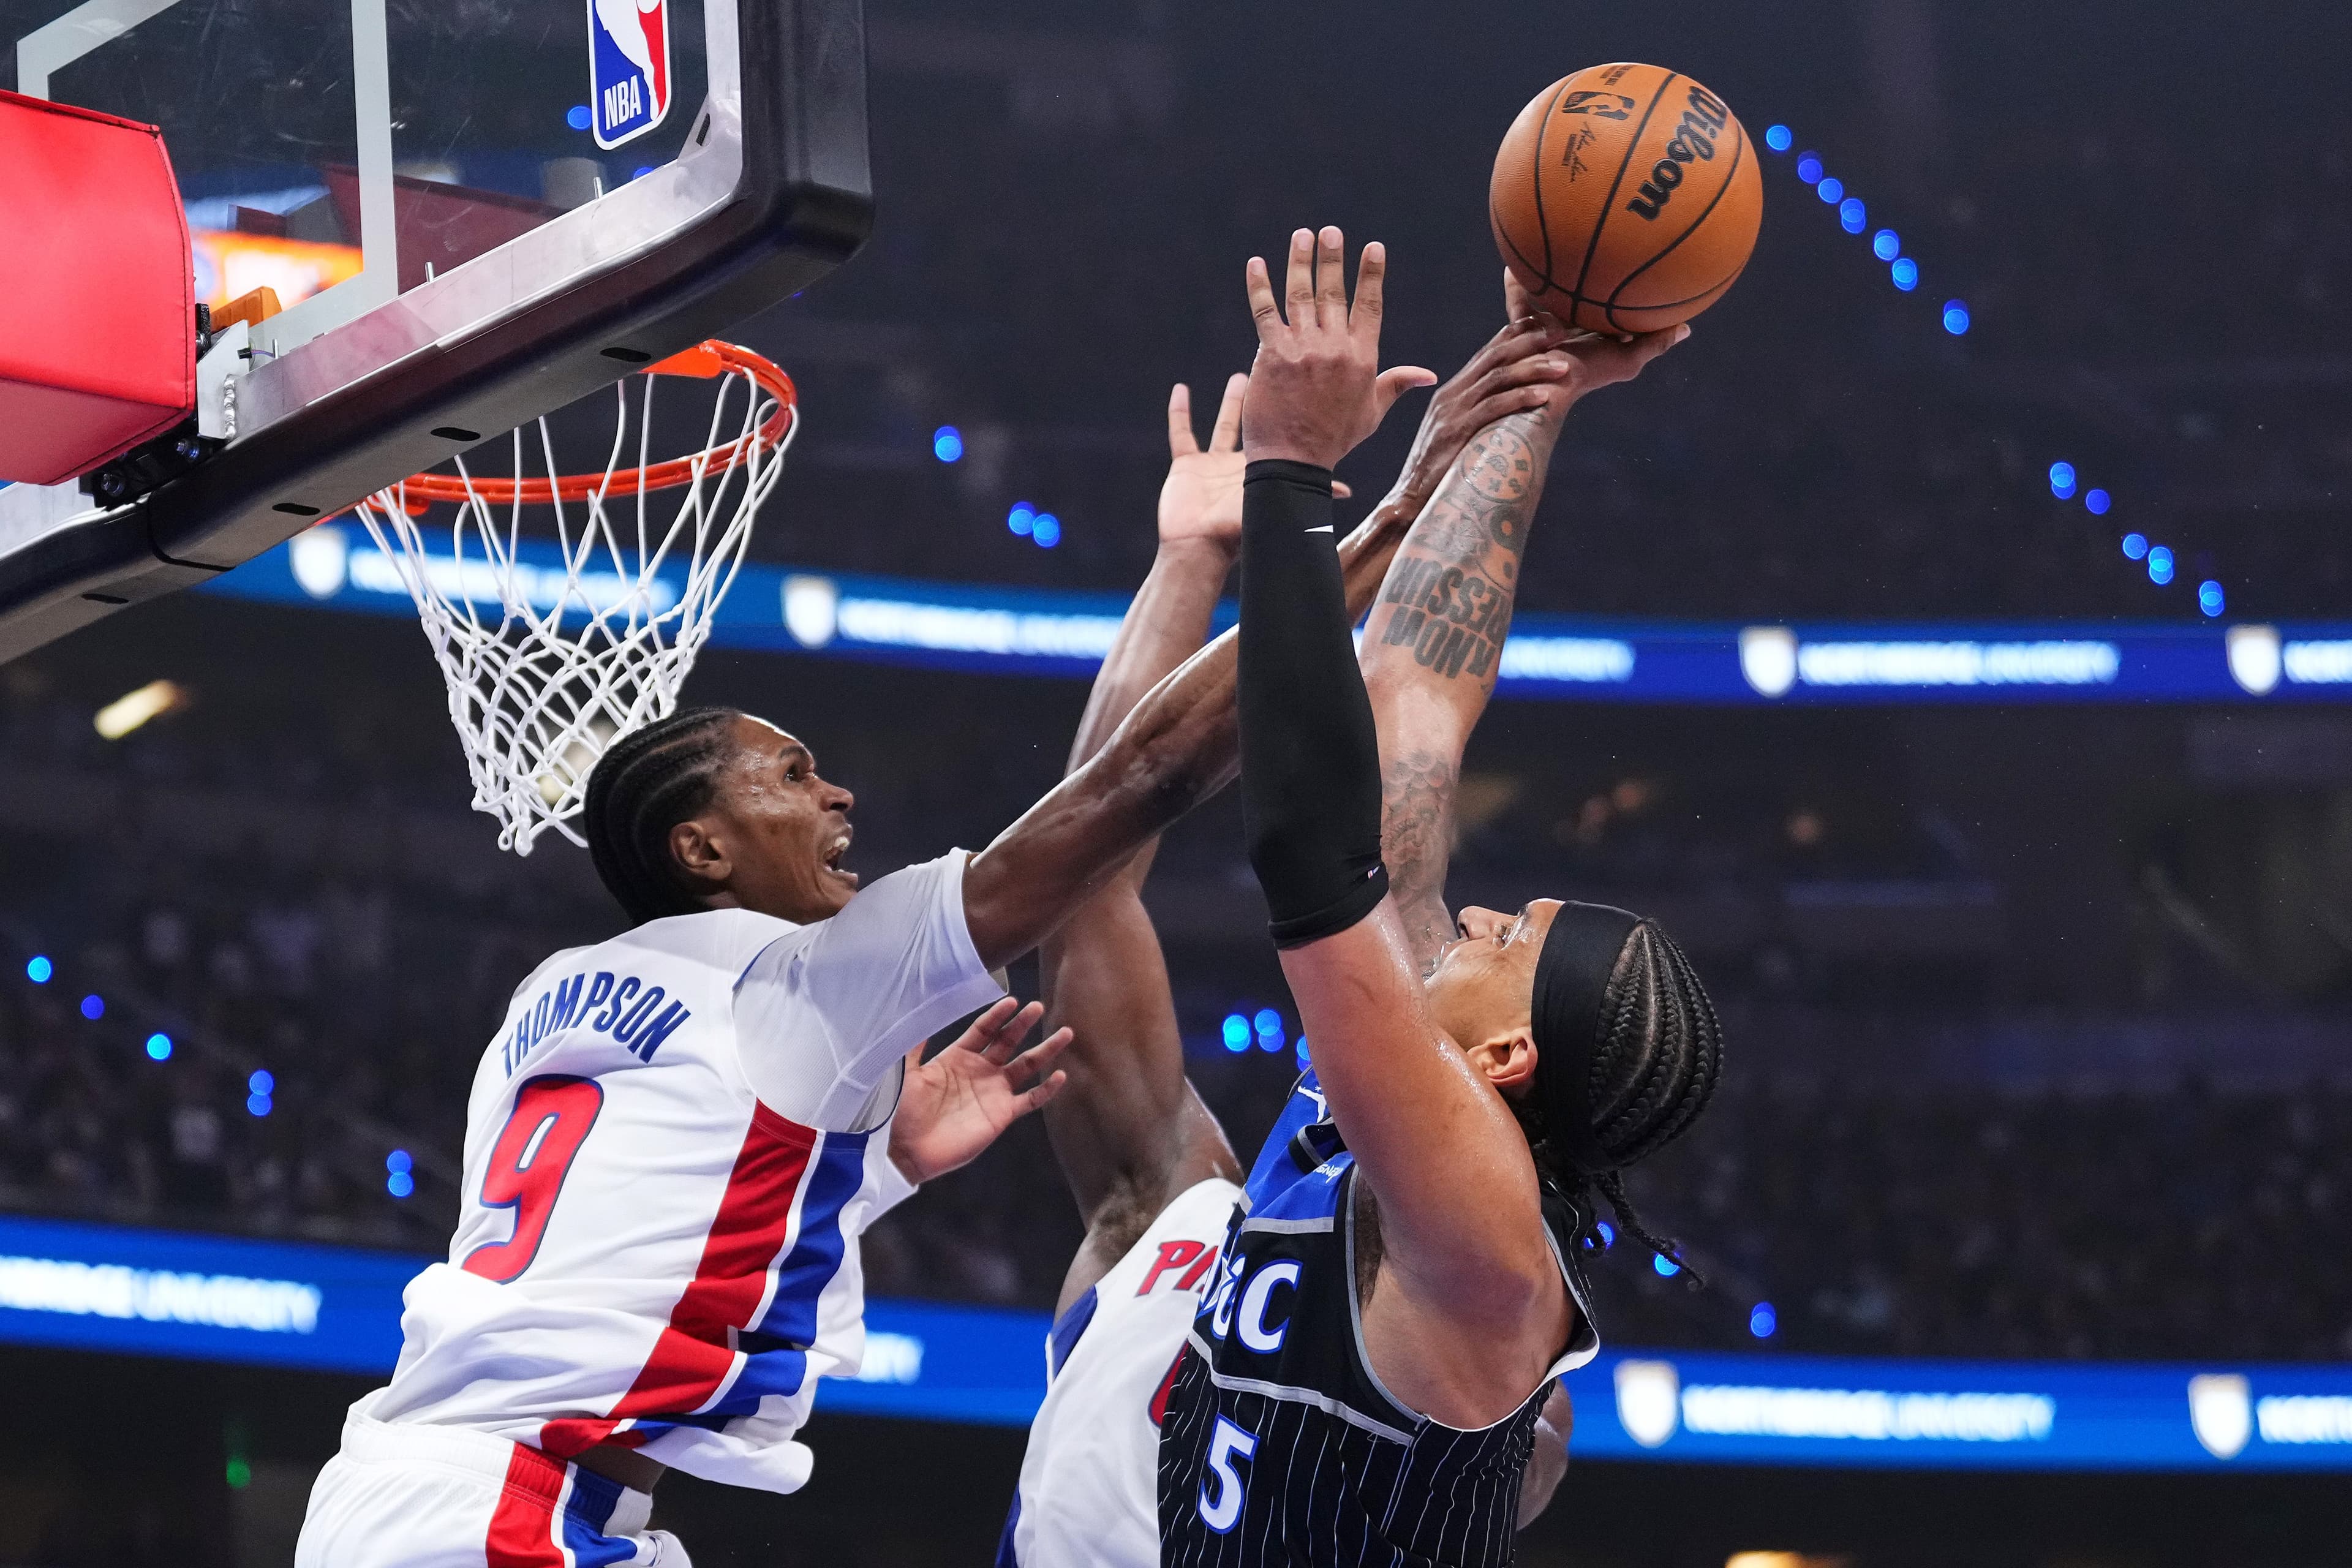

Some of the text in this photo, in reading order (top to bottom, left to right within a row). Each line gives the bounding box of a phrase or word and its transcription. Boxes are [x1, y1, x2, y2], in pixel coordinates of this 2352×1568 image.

[604, 75, 642, 130] NBA
[1626, 86, 1727, 222] Wilson
[500, 971, 692, 1080] THOMPSON
[461, 1073, 605, 1286] 9
[1197, 1412, 1261, 1535] 5
